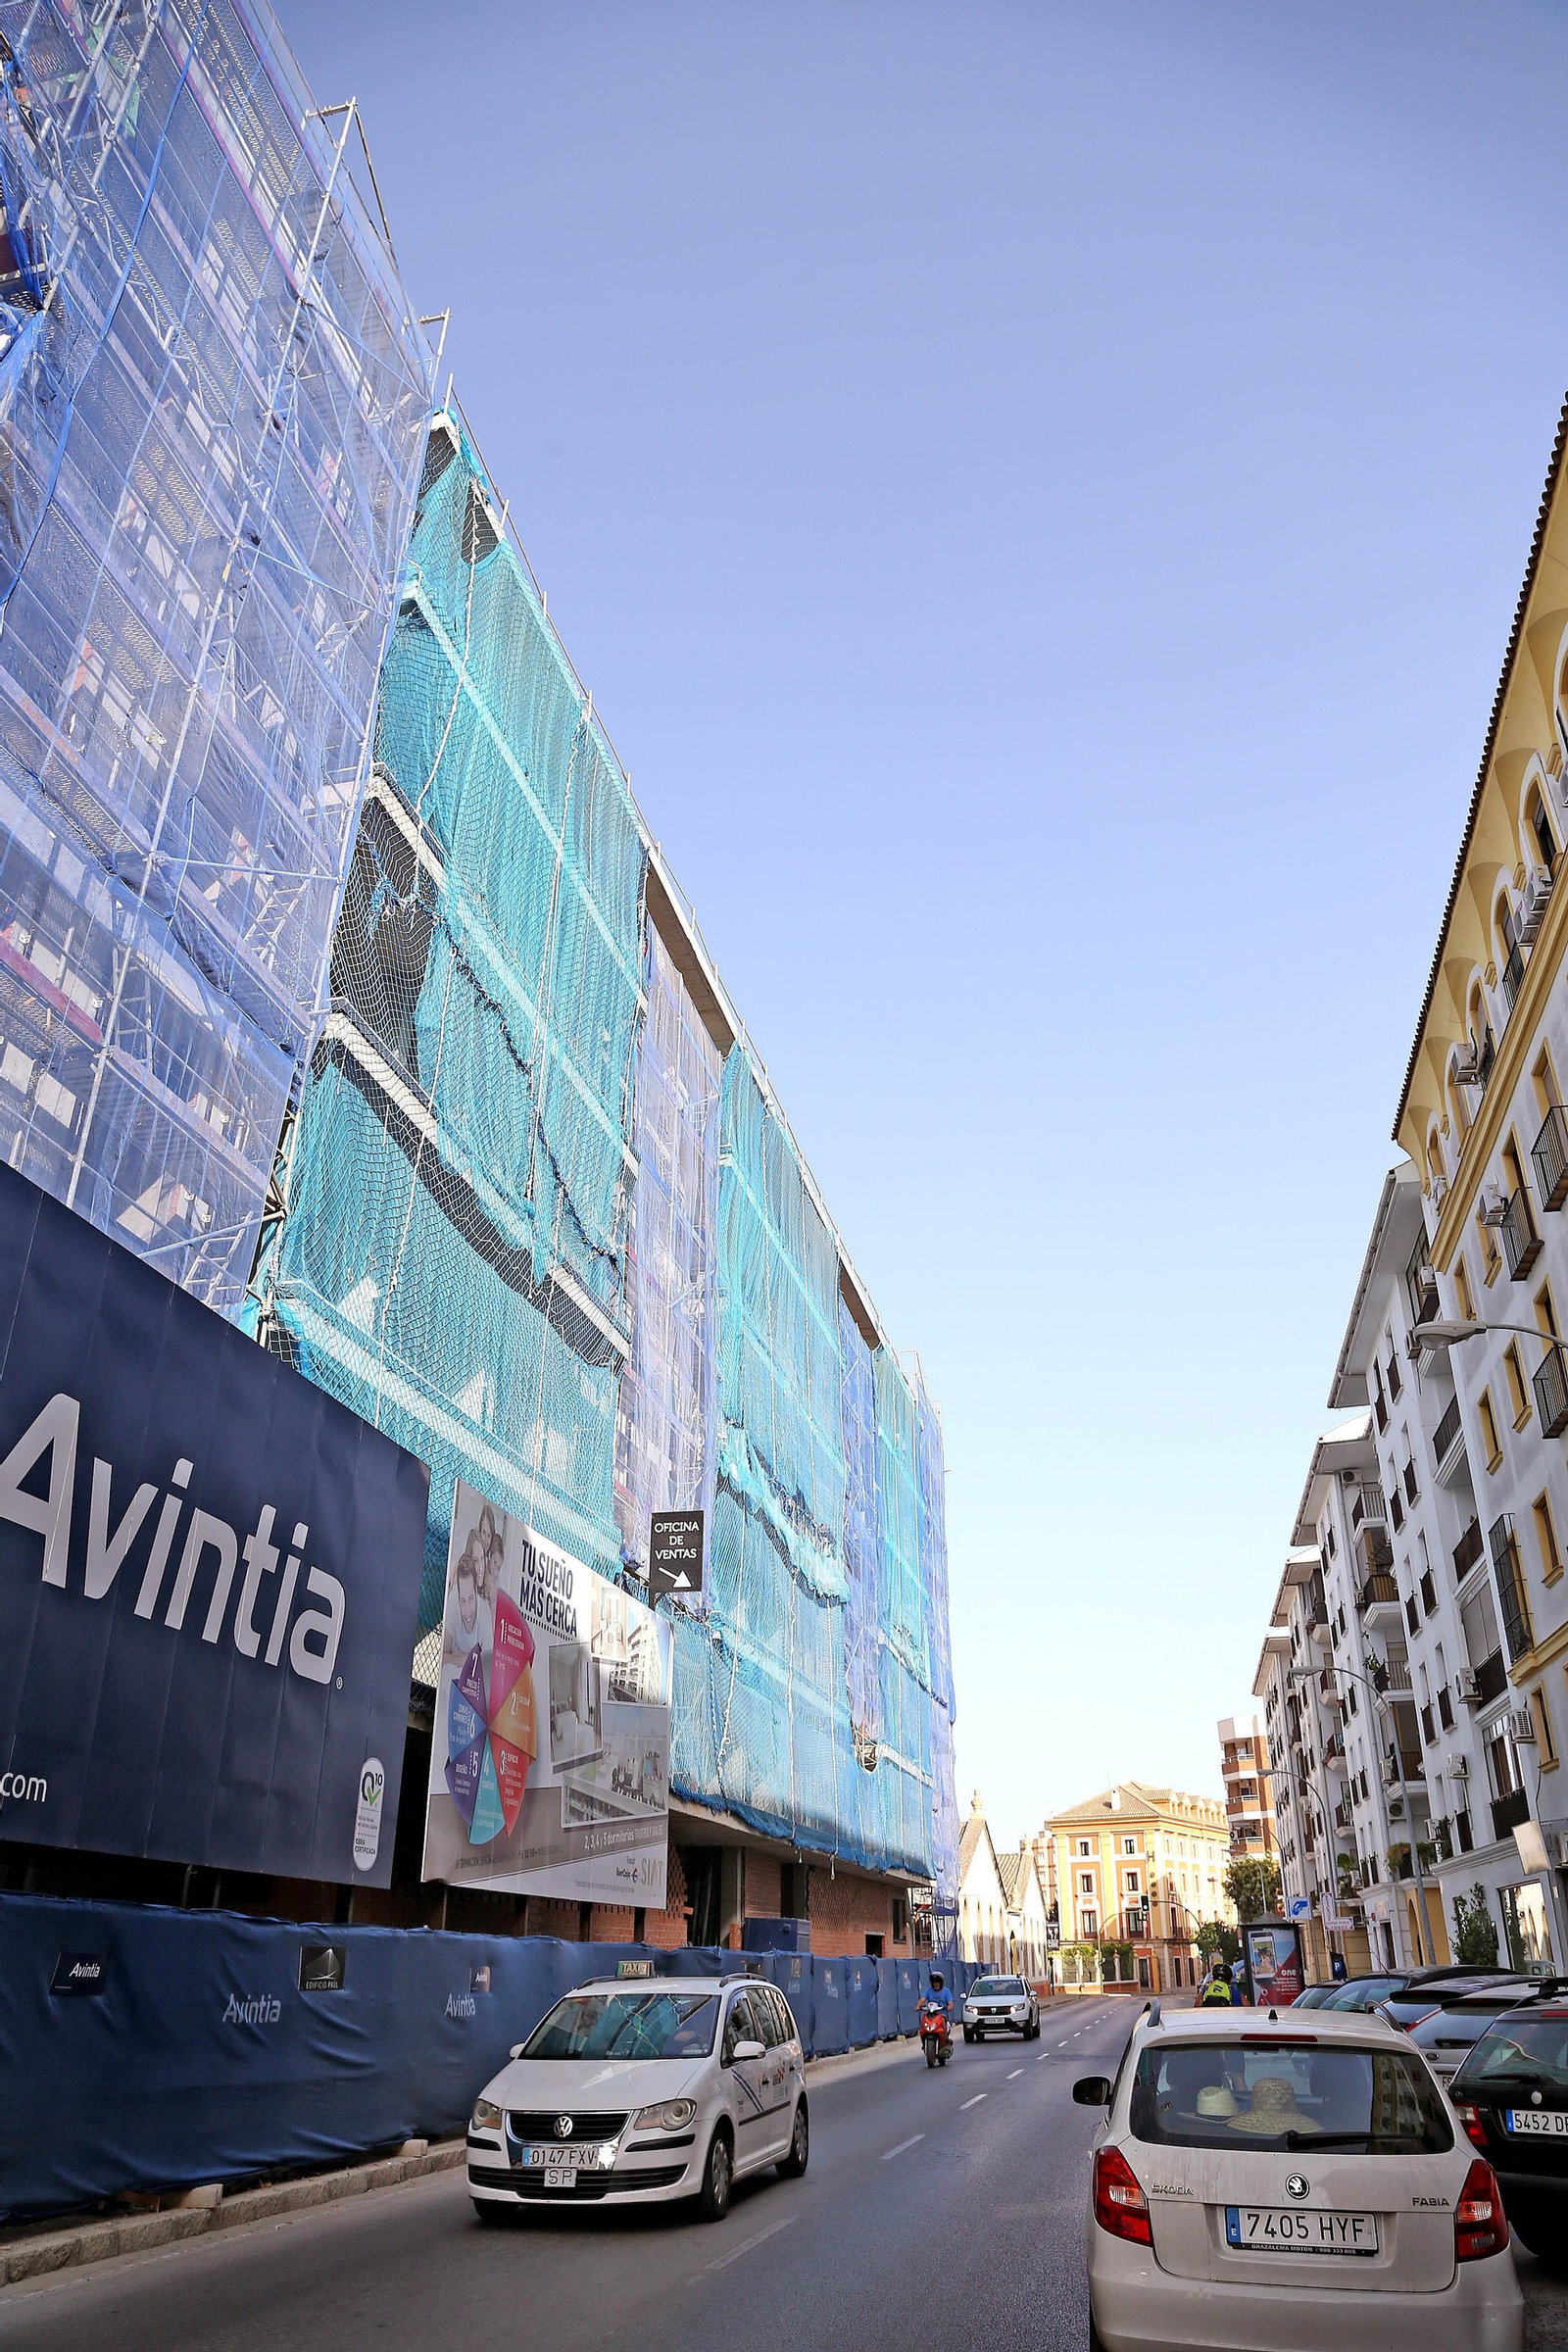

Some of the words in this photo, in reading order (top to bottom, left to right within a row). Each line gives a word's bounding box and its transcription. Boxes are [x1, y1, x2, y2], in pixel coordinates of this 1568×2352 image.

[0, 1393, 346, 1685] Avintia
[654, 1521, 700, 1534] OFICINA
[668, 1535, 684, 1545] DE
[655, 1548, 697, 1560] VENTAS
[521, 1539, 536, 1578] TU
[537, 1551, 573, 1600] SUEÑO
[519, 1576, 545, 1618] MÁS
[545, 1592, 577, 1638] CERCA
[500, 1618, 505, 1642] 1
[472, 1652, 478, 1678] 7
[511, 1691, 516, 1715] 2
[470, 1713, 475, 1739] 6
[472, 1750, 478, 1778] 5
[483, 1751, 490, 1777] 4
[500, 1750, 506, 1775] 3
[69, 1962, 101, 1978] Avintia
[622, 1962, 641, 1973] TAXI
[1334, 1962, 1341, 1971] P
[306, 1981, 326, 1989] EDIFICIO
[221, 1993, 281, 2024] Avintia
[444, 1993, 476, 2017] Avintia
[1514, 2113, 1550, 2131] 5452
[568, 2150, 595, 2165] FXV
[548, 2169, 572, 2184] SP
[1412, 2197, 1450, 2206] FABIA
[1231, 2228, 1237, 2236] E
[1247, 2213, 1309, 2239] 7405
[1318, 2216, 1365, 2242] HYF
